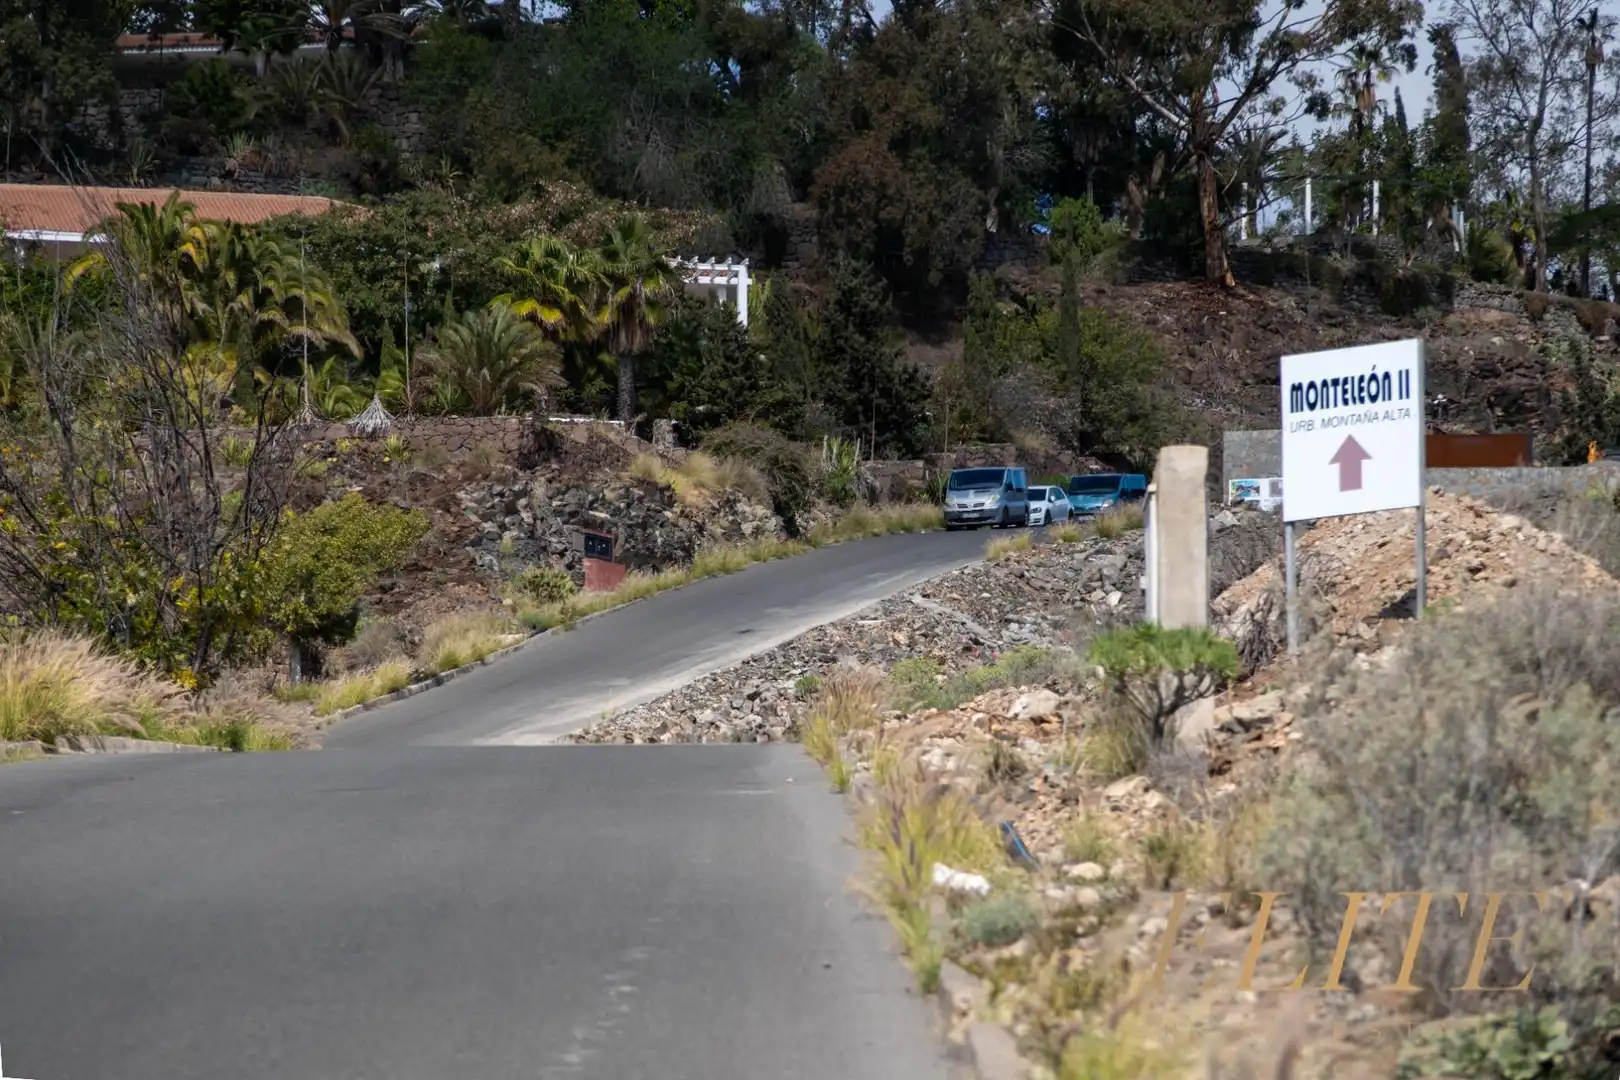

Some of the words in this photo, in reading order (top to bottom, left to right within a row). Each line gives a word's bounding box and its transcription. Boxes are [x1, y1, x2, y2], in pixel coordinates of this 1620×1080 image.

[1290, 364, 1392, 413] MONTELEÓN
[1398, 368, 1410, 400] II
[1321, 411, 1379, 429] MONTAÑA
[1382, 408, 1410, 422] ALTA
